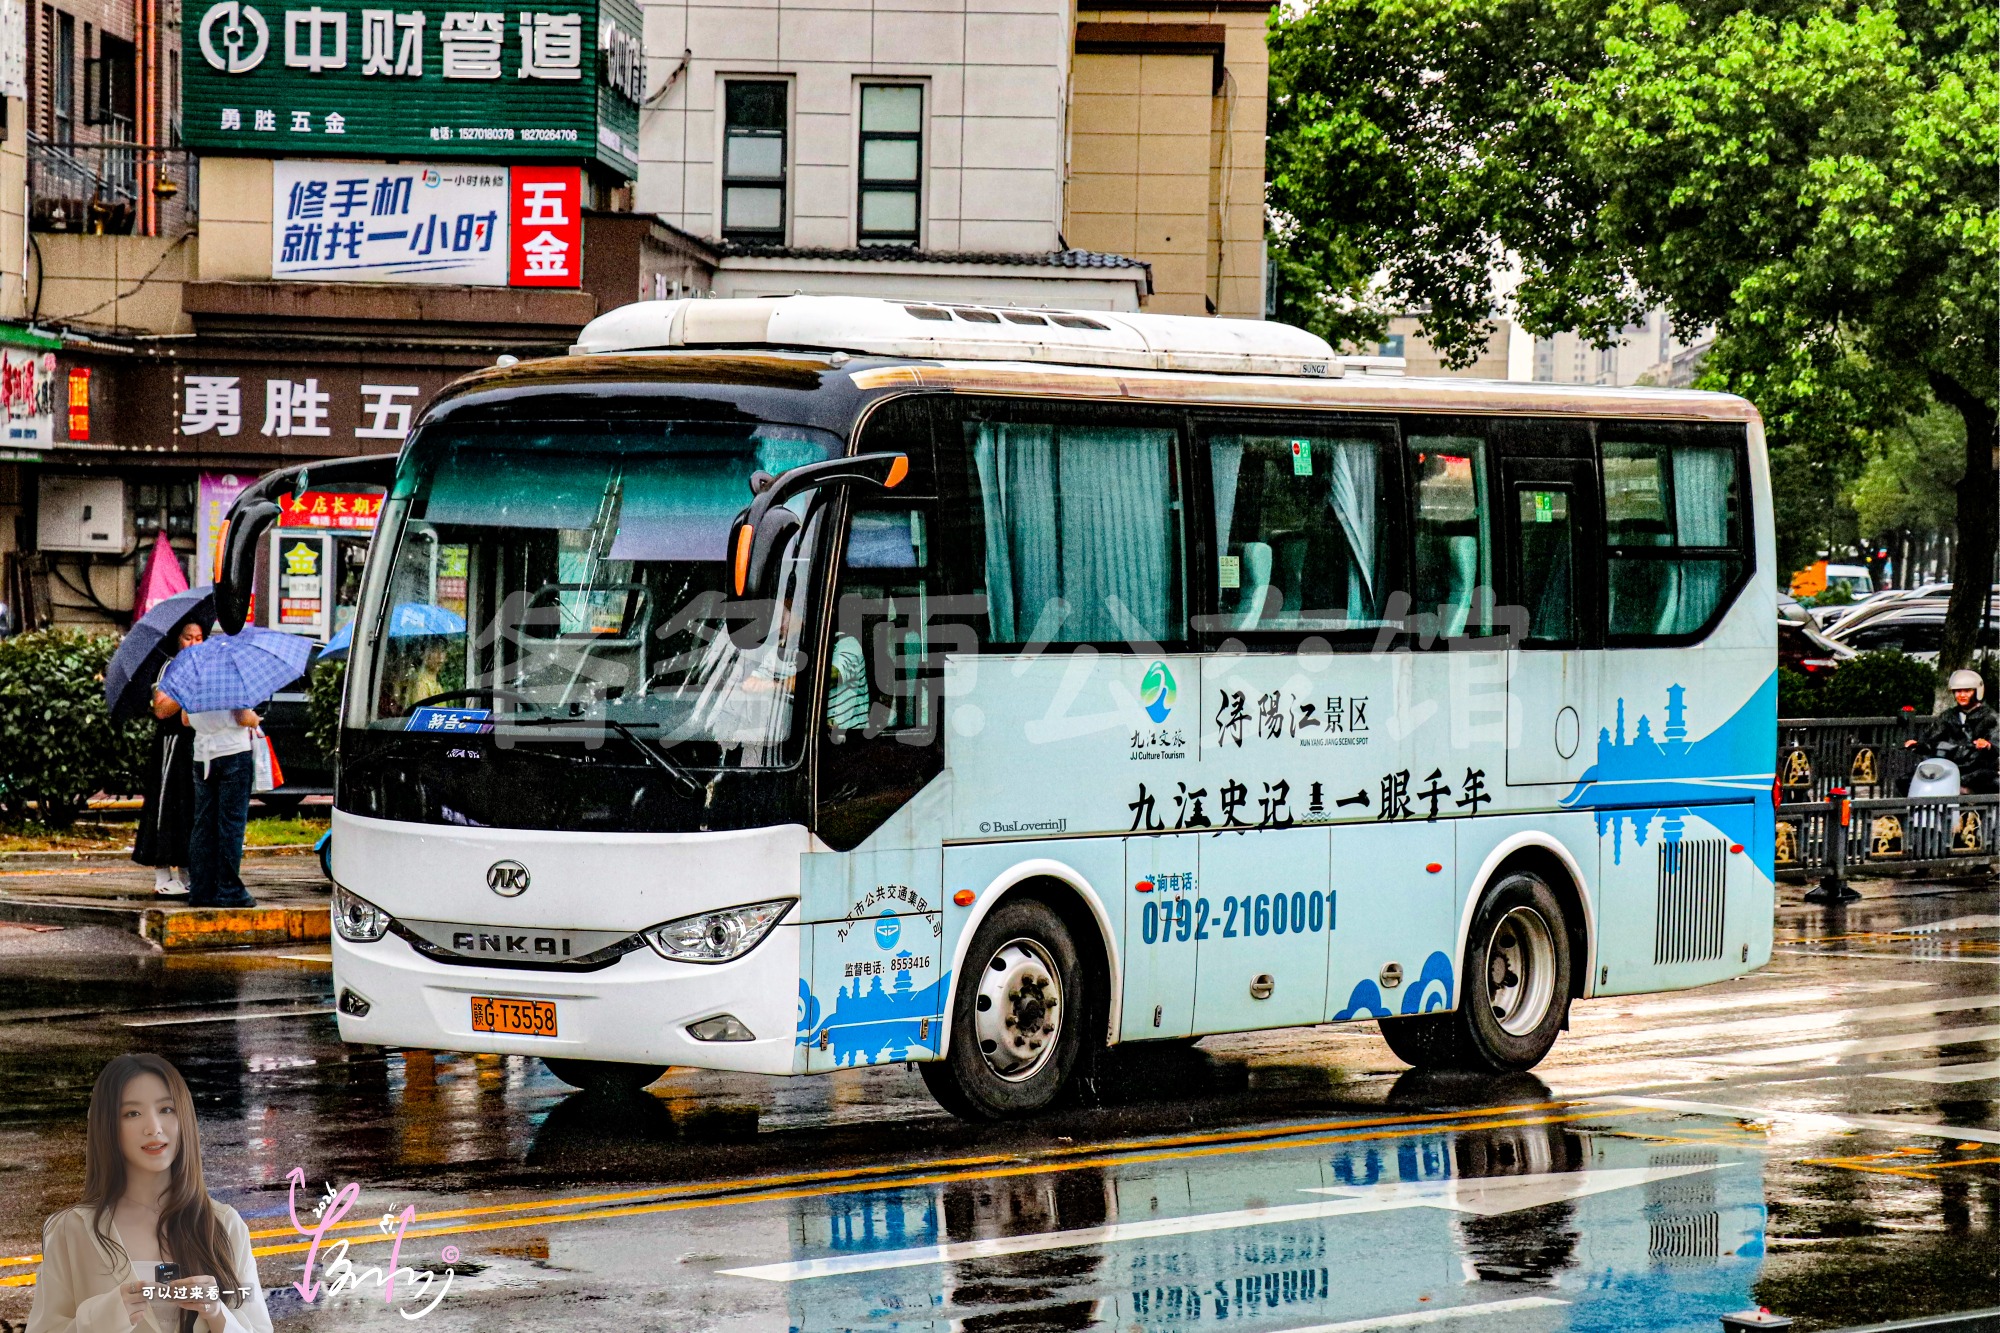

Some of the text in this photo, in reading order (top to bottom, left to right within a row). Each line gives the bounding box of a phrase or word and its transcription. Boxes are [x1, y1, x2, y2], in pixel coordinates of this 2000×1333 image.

[285, 7, 582, 79] 中财管道
[221, 108, 346, 134] 勇胜五金
[459, 128, 515, 141] 15270180378
[520, 129, 578, 141] 18270264706
[442, 174, 504, 188] 一小时快修
[287, 176, 414, 221] 修手机
[280, 210, 498, 263] 就找一小时
[521, 182, 569, 277] 五金
[284, 542, 319, 575] 金
[1138, 751, 1160, 760] Culture
[1161, 751, 1185, 759] Tourism
[1356, 737, 1368, 745] SPOT
[1128, 767, 1492, 838] 九江史记 一眼千年
[1142, 890, 1337, 944] 0792-2160001
[453, 932, 570, 956] ANKAI
[890, 956, 930, 970] 8553416
